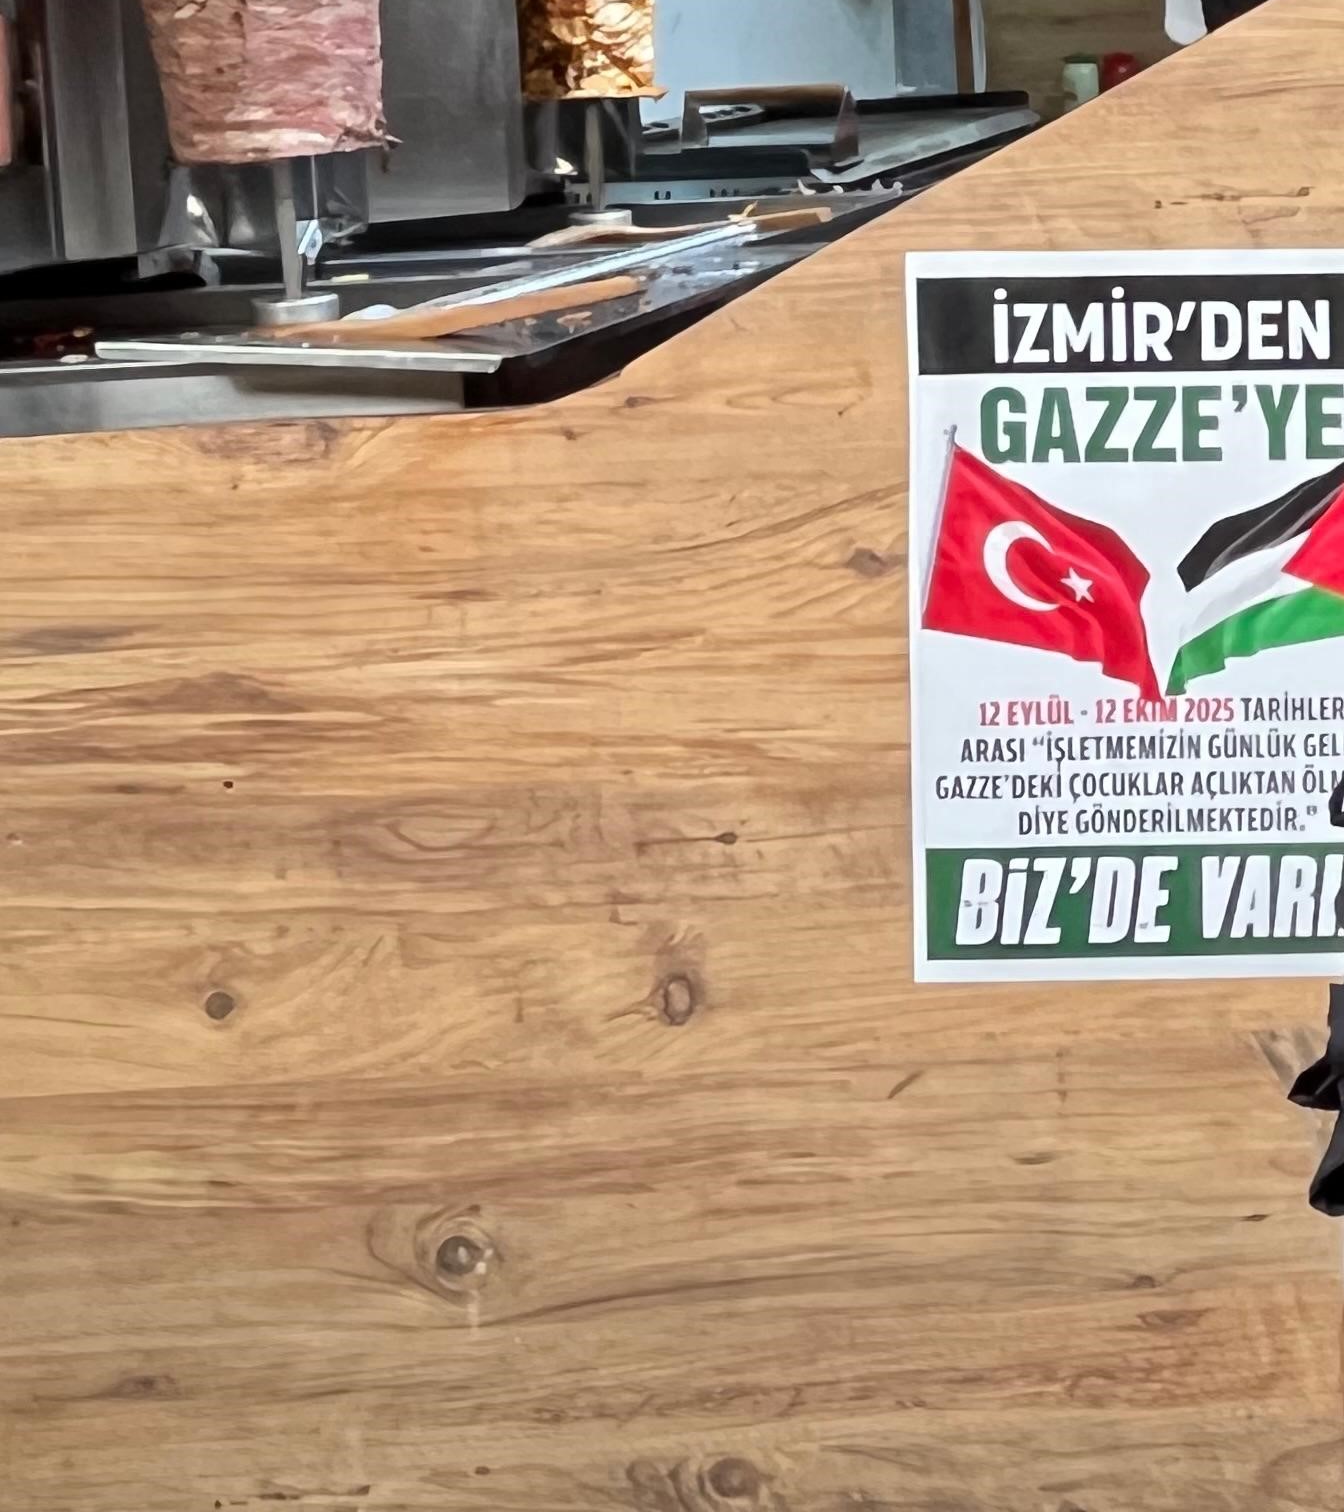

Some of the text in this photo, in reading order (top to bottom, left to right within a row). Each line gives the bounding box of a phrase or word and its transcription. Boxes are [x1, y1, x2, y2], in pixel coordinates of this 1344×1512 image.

[993, 286, 1331, 364] İZMİR'DEN
[980, 384, 1344, 463] GAZZE'YE
[979, 701, 1000, 726] 12
[1007, 695, 1074, 726] EYLÜL
[1095, 699, 1116, 723] 12
[1184, 698, 1235, 723] 2025
[960, 737, 1025, 763] ARASI
[1208, 728, 1296, 759] GÜNLÜK
[935, 771, 1062, 800] GAZZE'DEKİ
[1069, 771, 1184, 803] ÇOCUKLAR
[1191, 770, 1295, 800] AÇLIKTAN
[1018, 805, 1069, 835] DİYE
